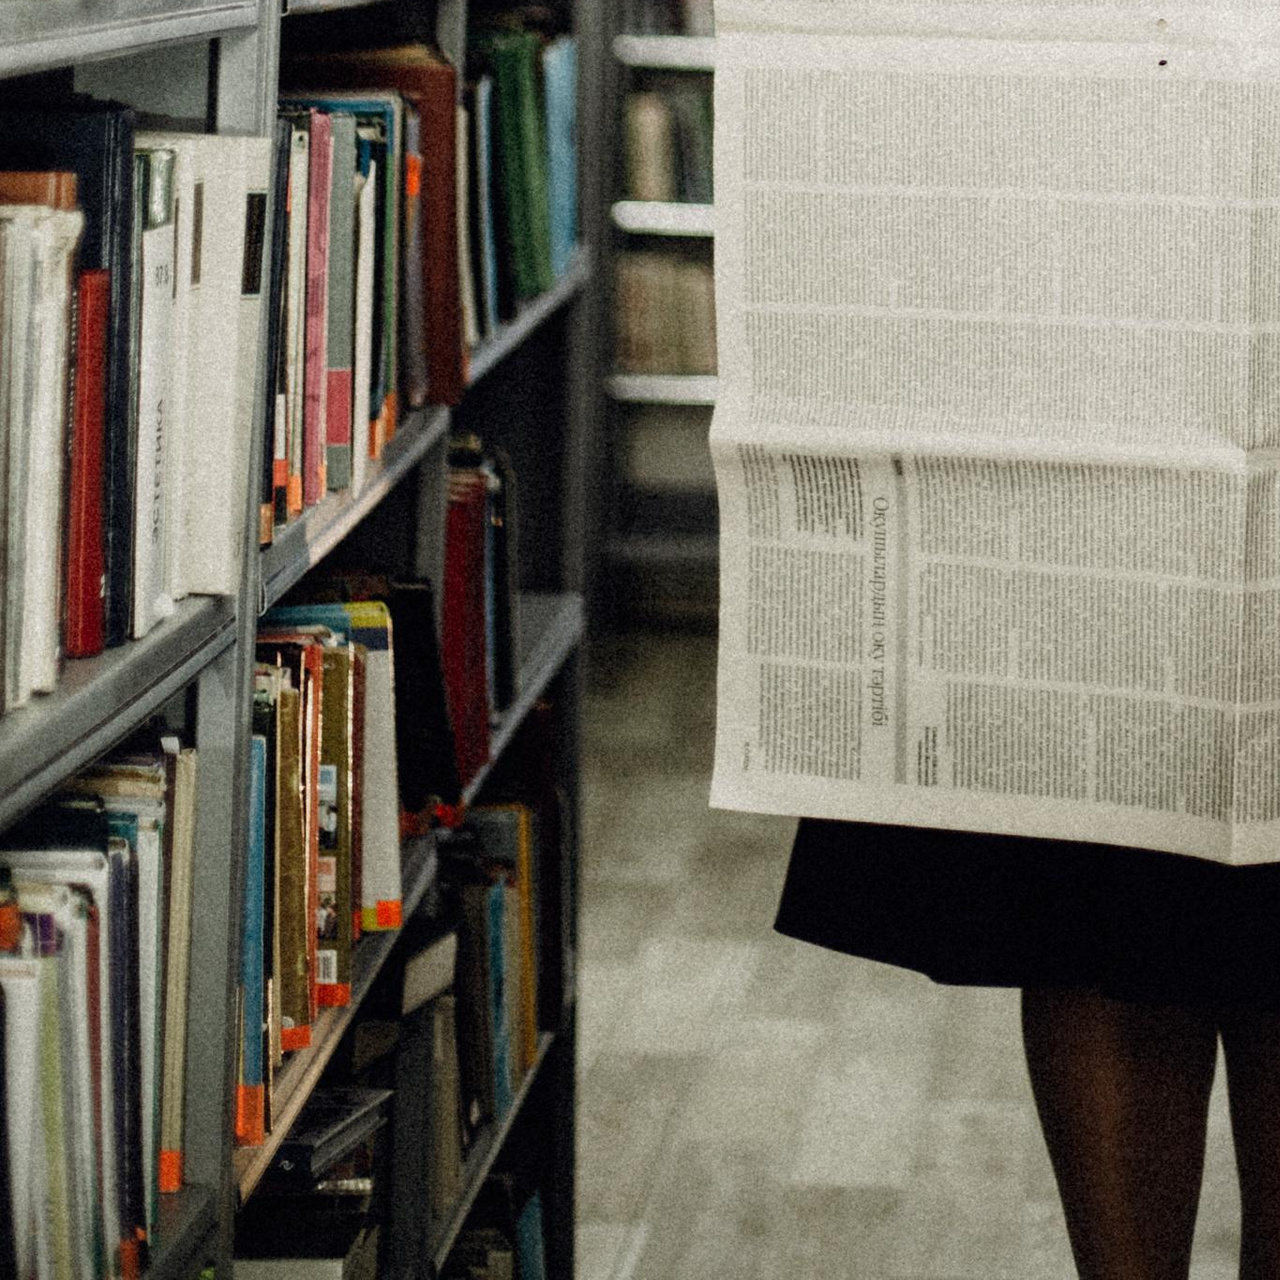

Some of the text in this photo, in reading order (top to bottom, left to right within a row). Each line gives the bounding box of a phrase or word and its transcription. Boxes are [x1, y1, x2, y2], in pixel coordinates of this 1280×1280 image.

[867, 495, 890, 728] Оқушылардың оқу тәртібі
